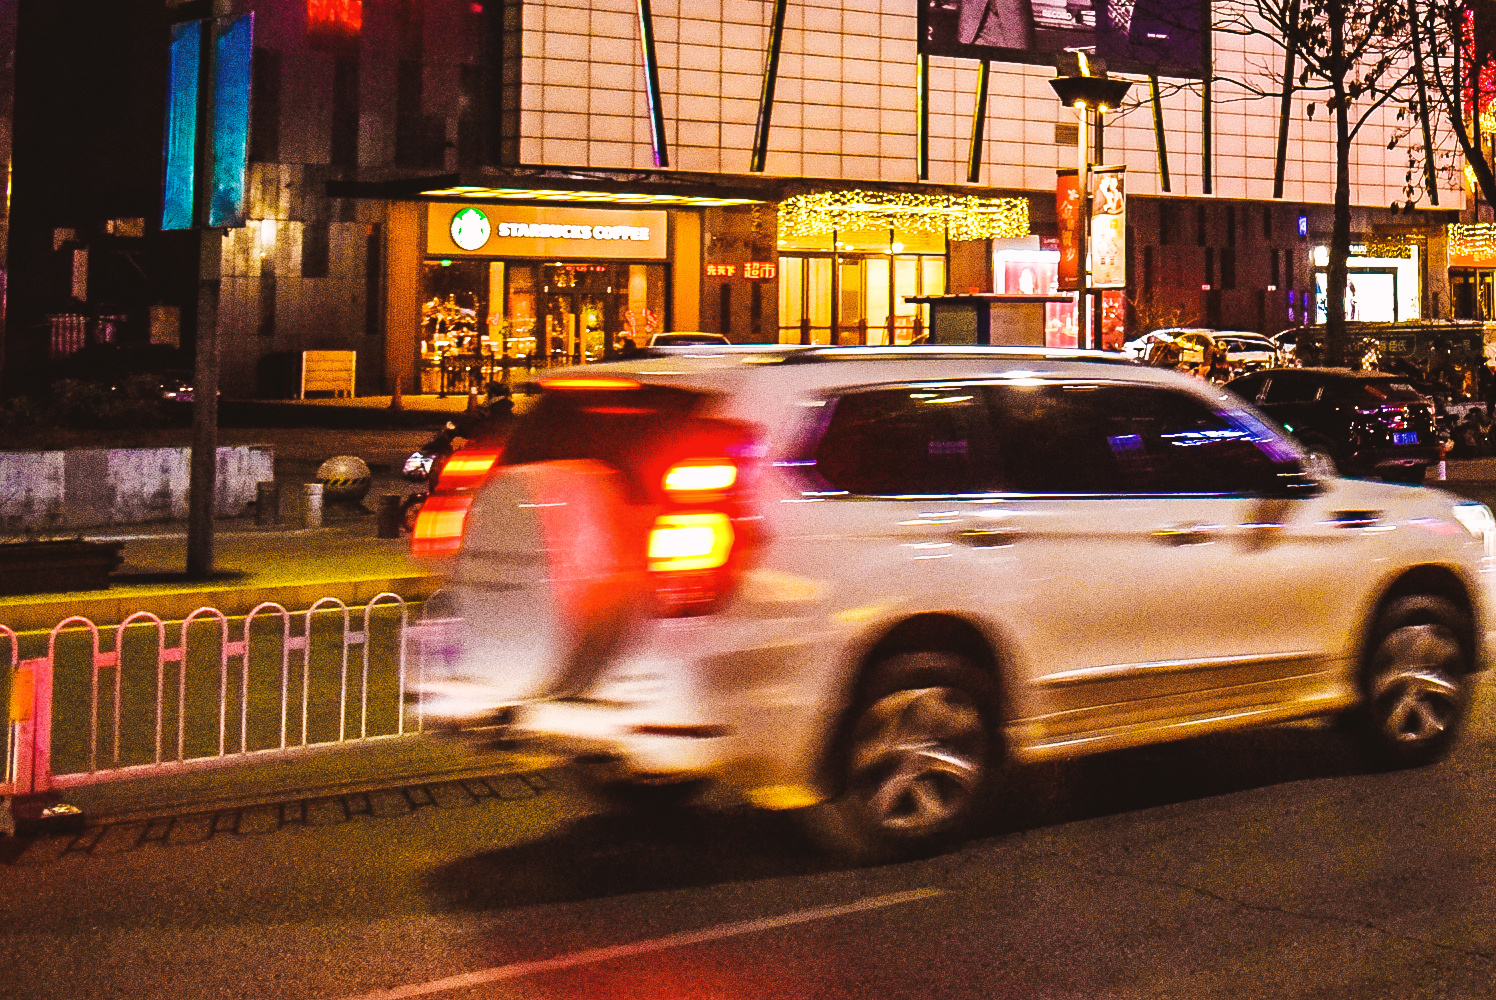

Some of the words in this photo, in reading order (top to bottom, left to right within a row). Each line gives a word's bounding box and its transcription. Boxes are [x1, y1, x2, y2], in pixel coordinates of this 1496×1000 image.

[498, 222, 592, 240] STARBUCKS
[593, 225, 650, 241] COFFEE
[706, 264, 737, 277] 先天下
[744, 262, 777, 279] 超市
